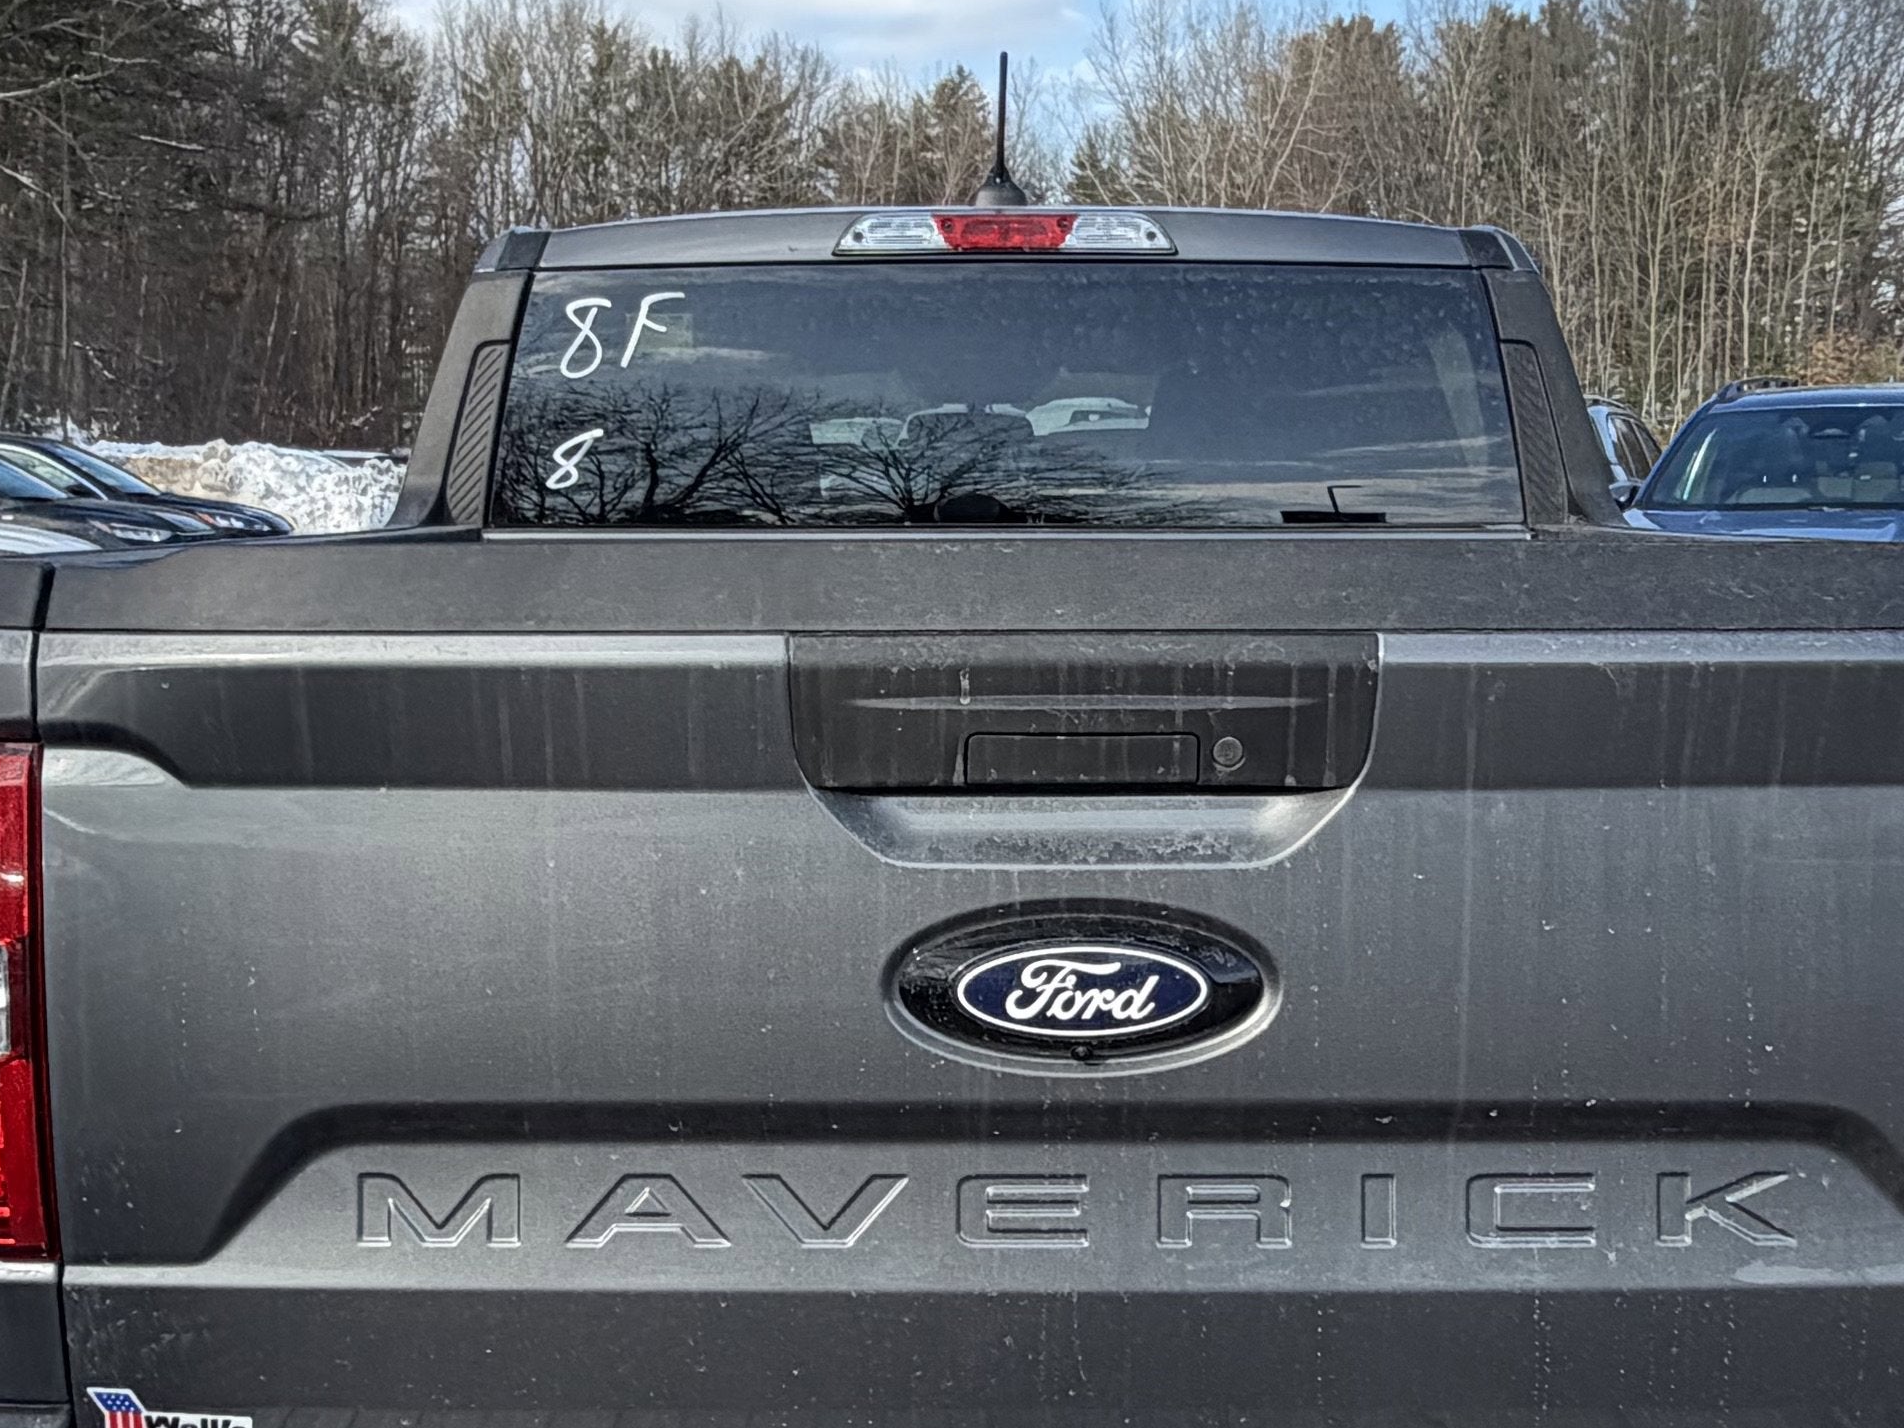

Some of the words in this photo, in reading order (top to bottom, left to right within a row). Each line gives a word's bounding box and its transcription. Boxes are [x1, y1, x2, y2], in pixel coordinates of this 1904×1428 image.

[545, 428, 604, 490] 8
[1005, 959, 1159, 1021] Ford
[356, 1171, 1797, 1249] MAVERICK
